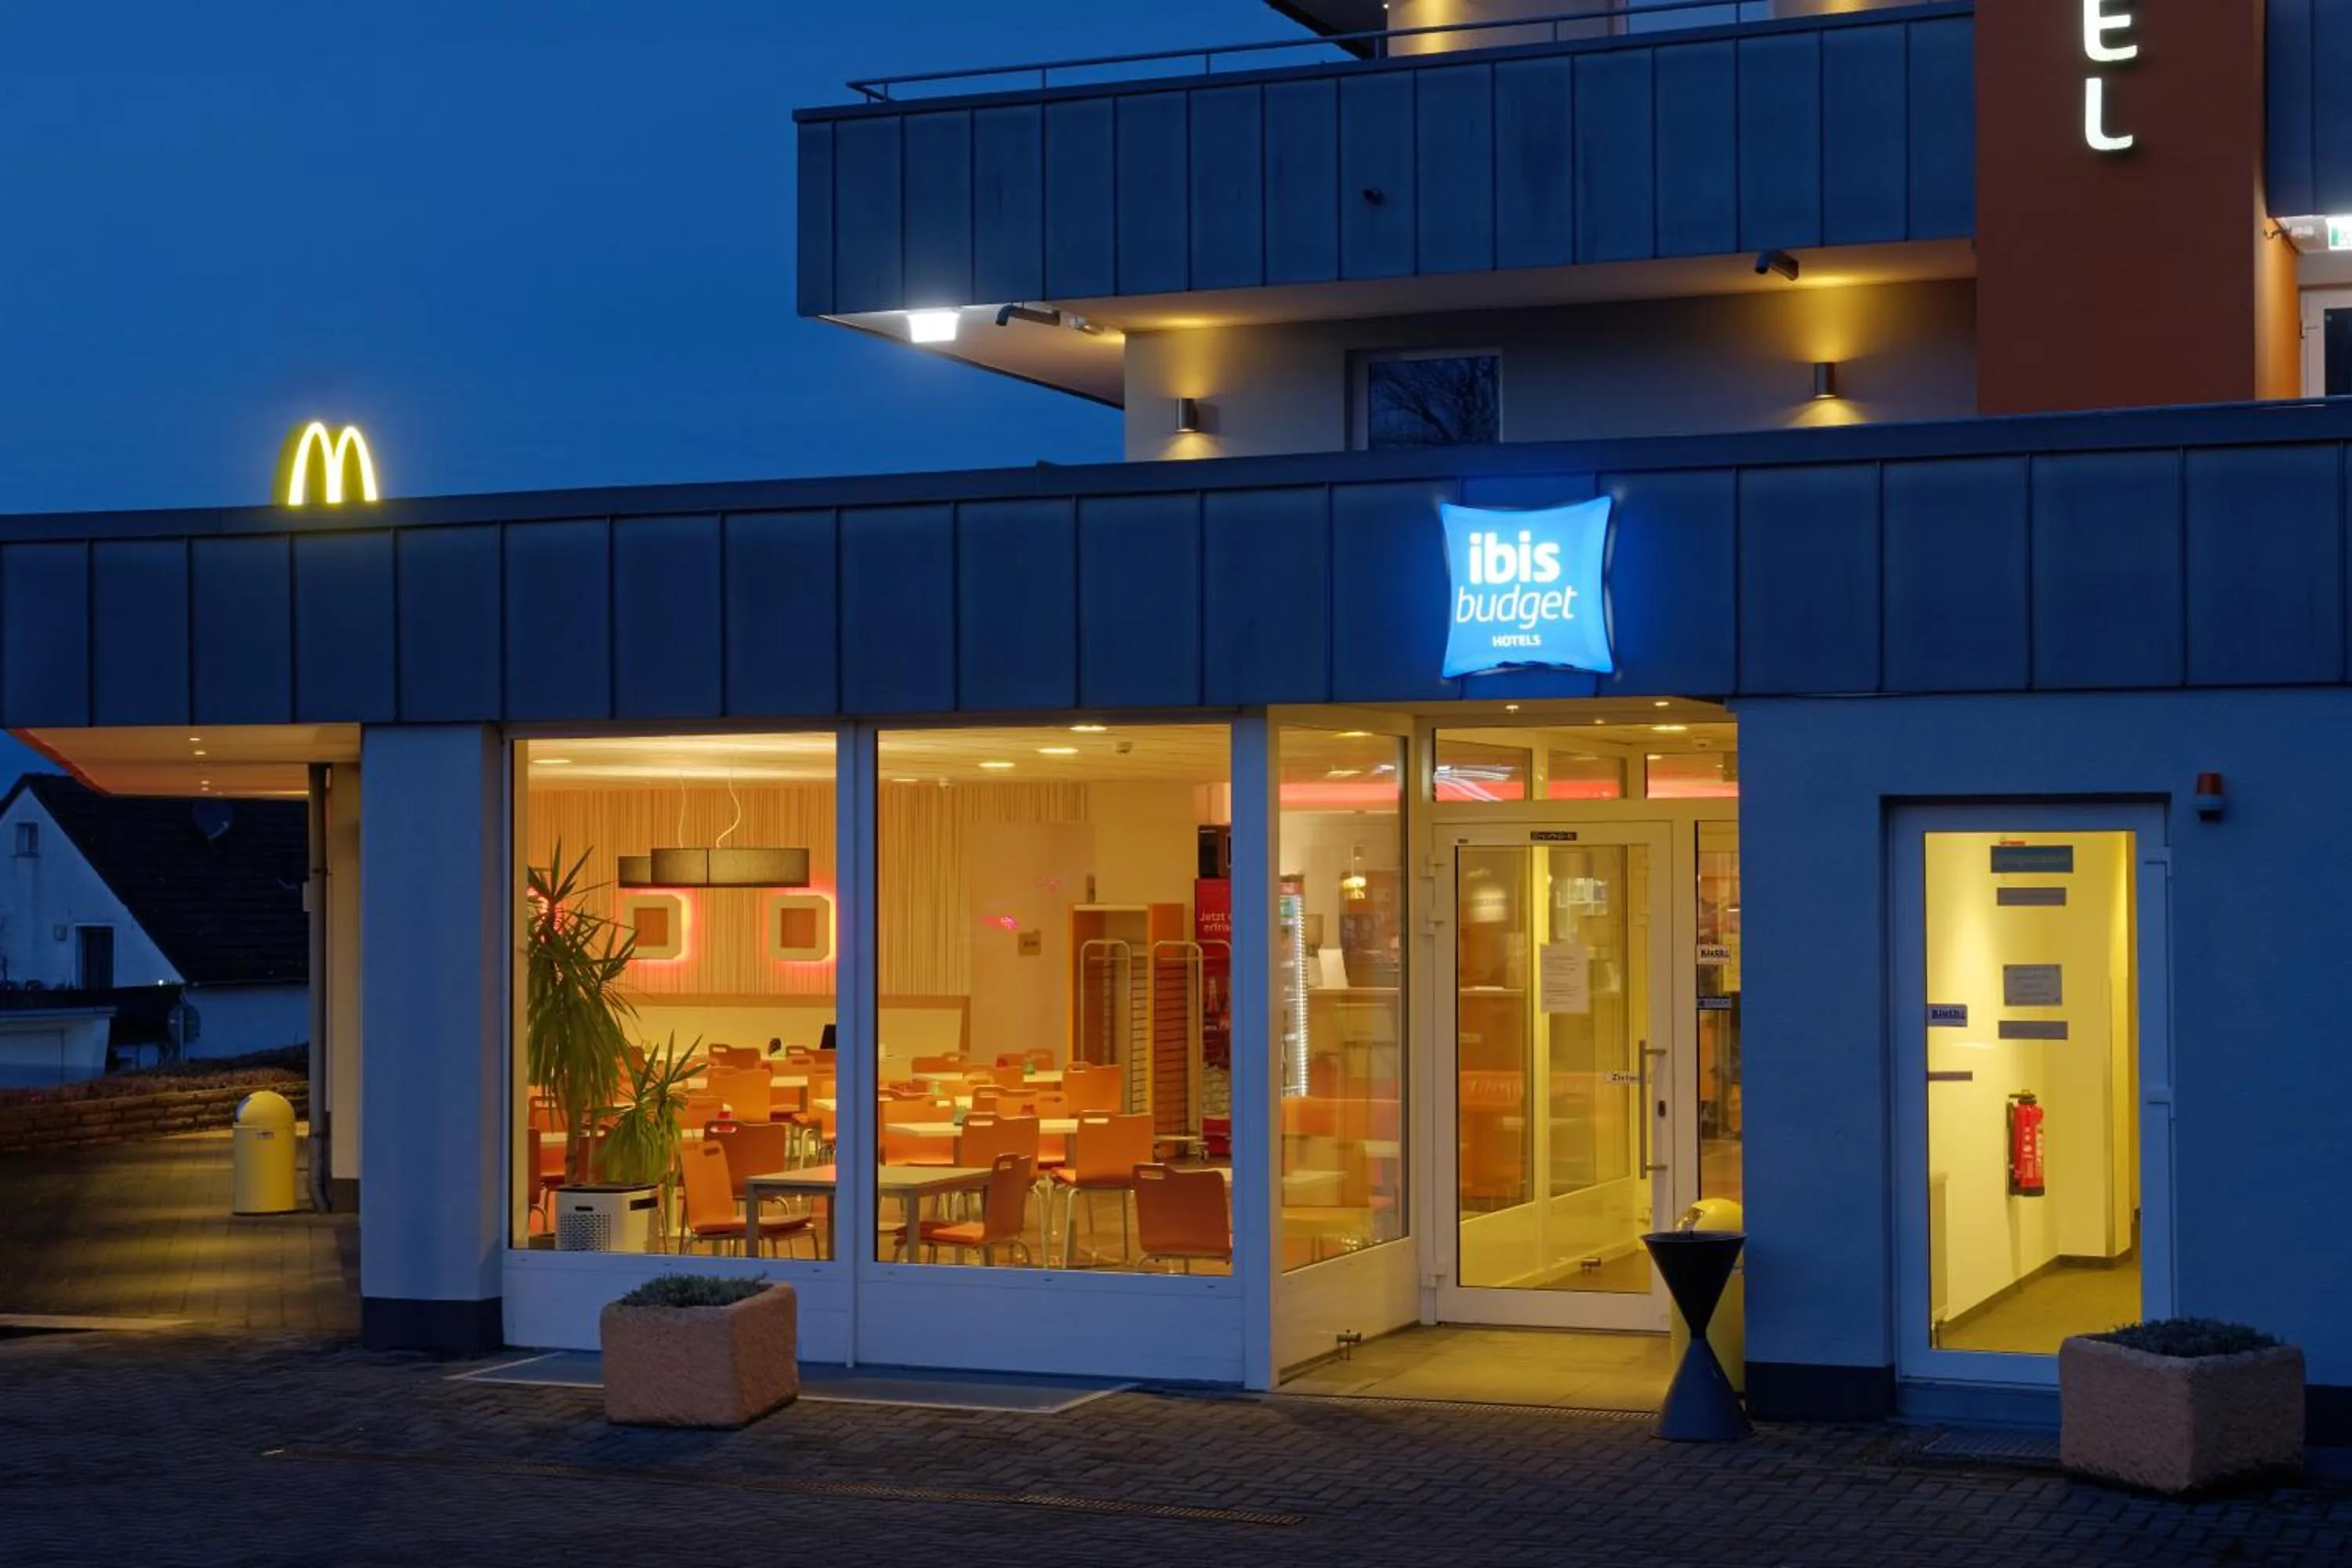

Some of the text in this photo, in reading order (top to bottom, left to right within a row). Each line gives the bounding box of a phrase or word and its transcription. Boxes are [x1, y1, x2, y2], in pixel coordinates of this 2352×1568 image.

[1468, 529, 1561, 585] ibis
[1455, 583, 1578, 630] budget
[1492, 633, 1542, 647] HOTELS
